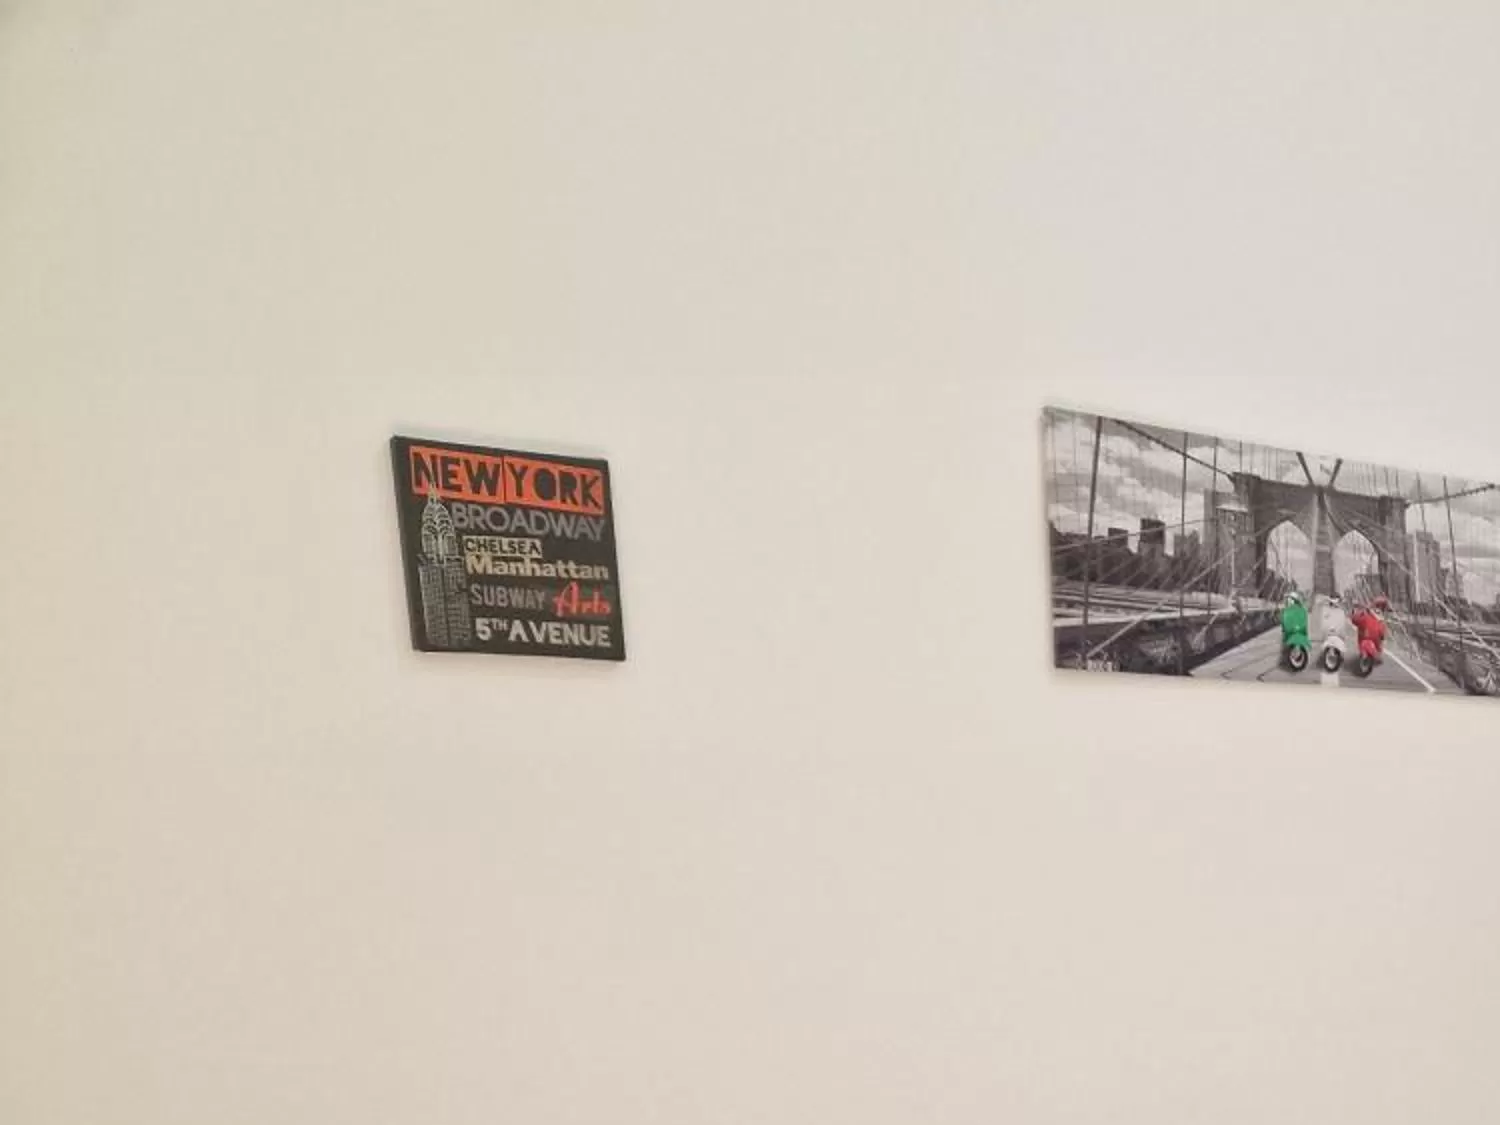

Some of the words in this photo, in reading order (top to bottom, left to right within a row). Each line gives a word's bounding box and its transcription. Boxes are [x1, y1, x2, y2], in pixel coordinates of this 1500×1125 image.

[412, 451, 501, 497] NEW
[506, 461, 601, 507] YORK
[451, 502, 605, 540] BROADWAY
[464, 538, 541, 556] CHELSEA
[466, 554, 609, 580] Manhattan
[470, 583, 545, 610] SUBWAY
[508, 620, 612, 647] AVENUE
